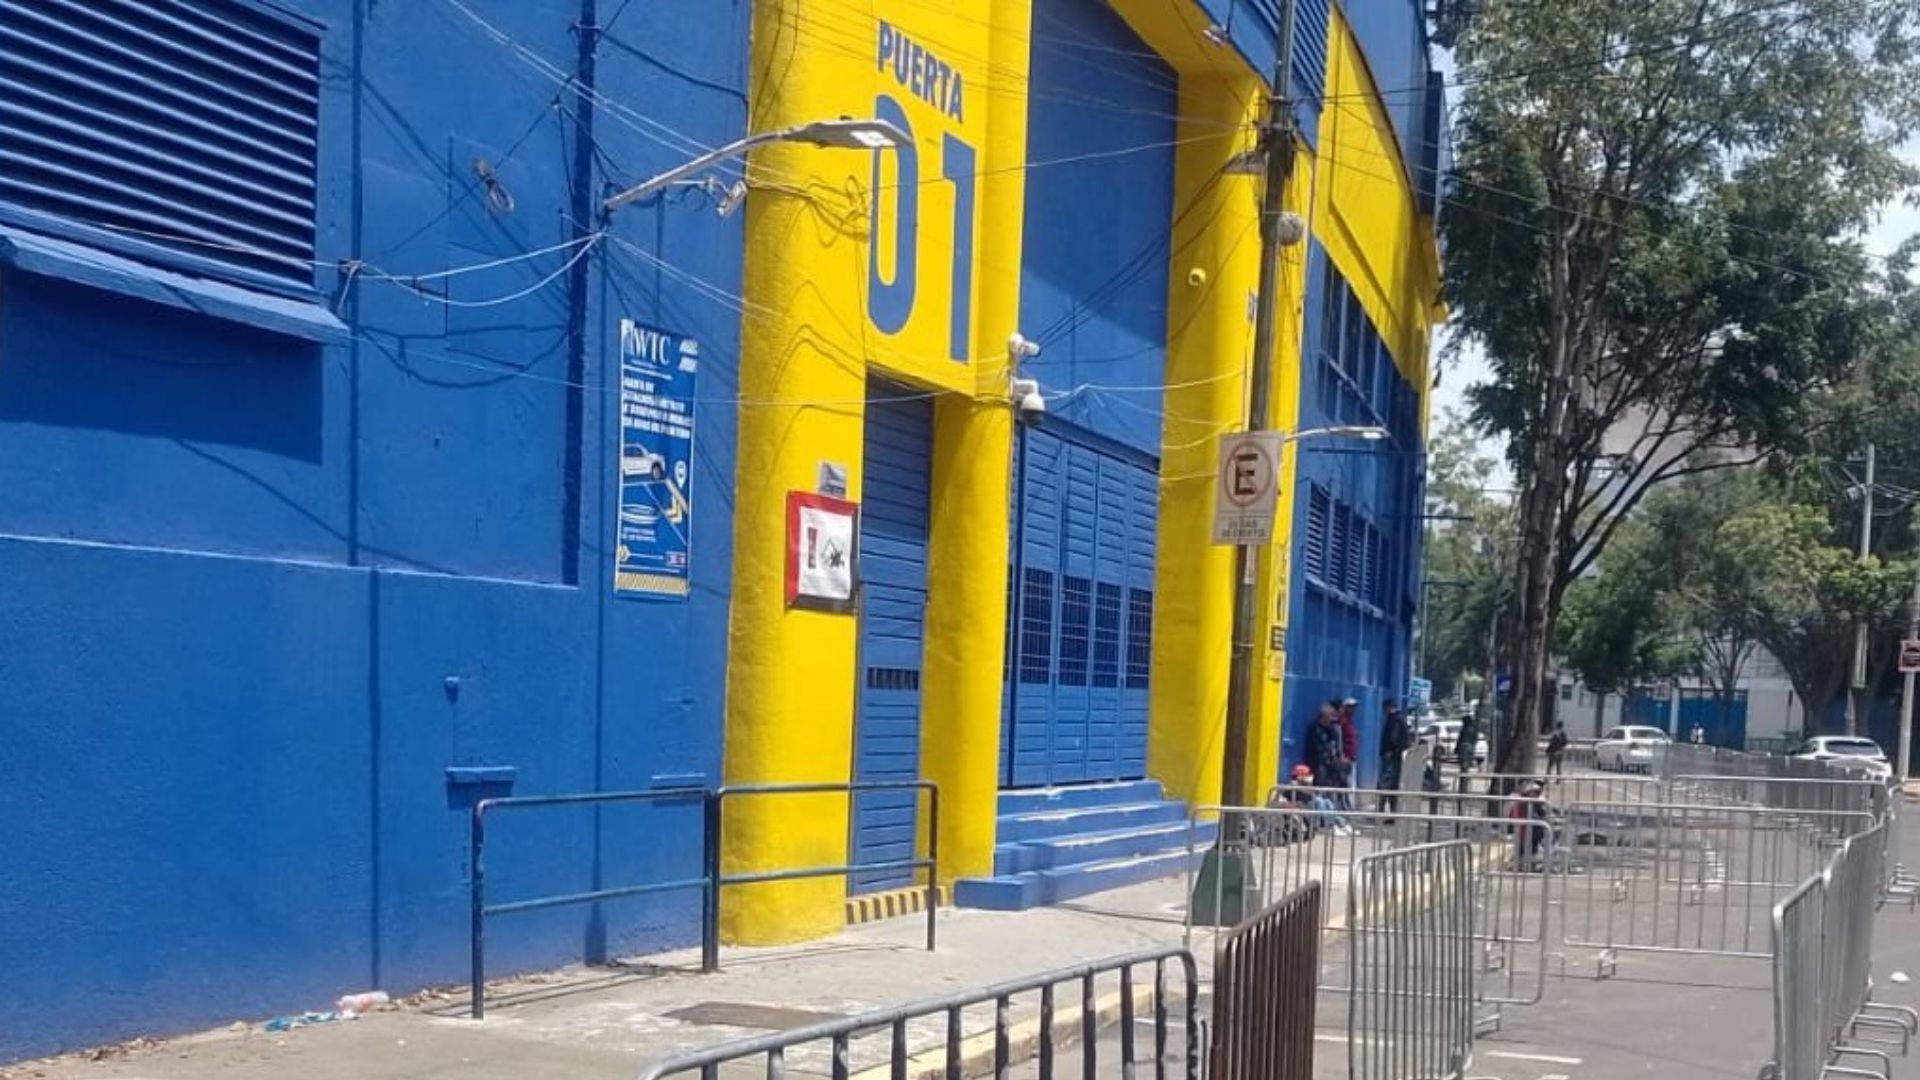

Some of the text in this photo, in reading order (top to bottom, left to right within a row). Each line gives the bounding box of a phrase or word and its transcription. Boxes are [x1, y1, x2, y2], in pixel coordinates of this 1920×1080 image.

[878, 19, 963, 124] PUERTA
[868, 94, 976, 366] 01
[1235, 452, 1258, 495] E
